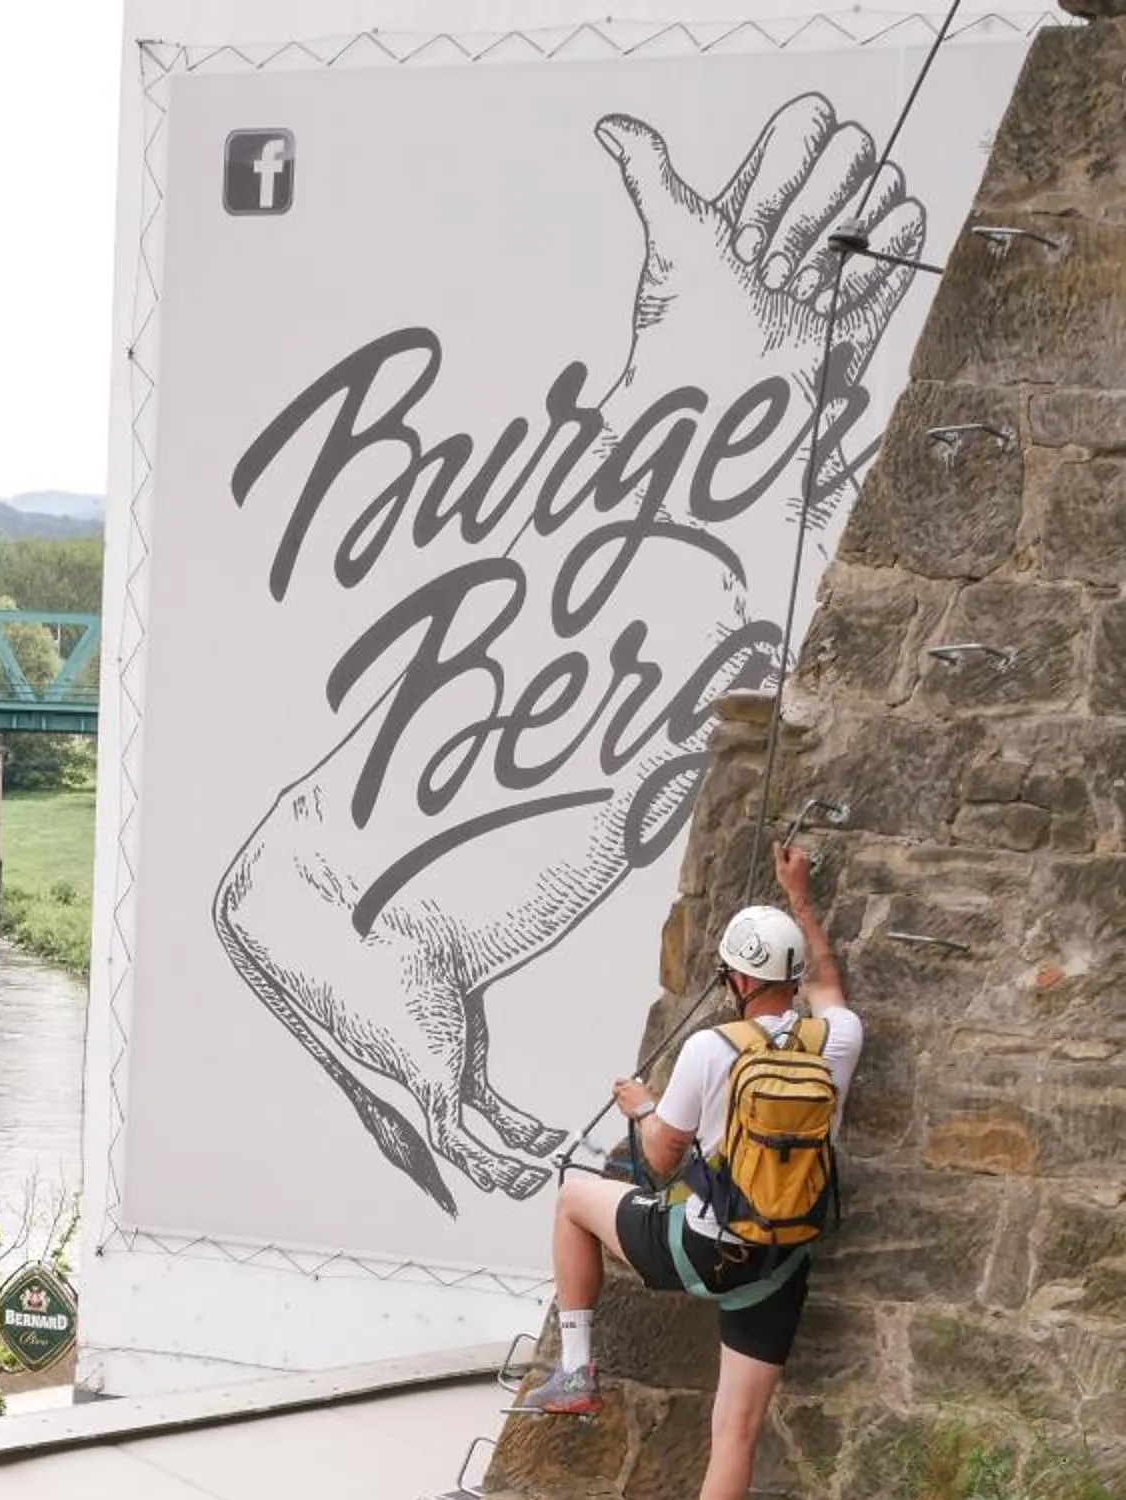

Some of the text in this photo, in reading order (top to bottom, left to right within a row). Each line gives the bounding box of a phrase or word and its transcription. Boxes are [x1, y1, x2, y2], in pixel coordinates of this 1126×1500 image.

[231, 327, 881, 637] Burger
[326, 556, 783, 868] Berg
[5, 1309, 68, 1331] BERNARD
